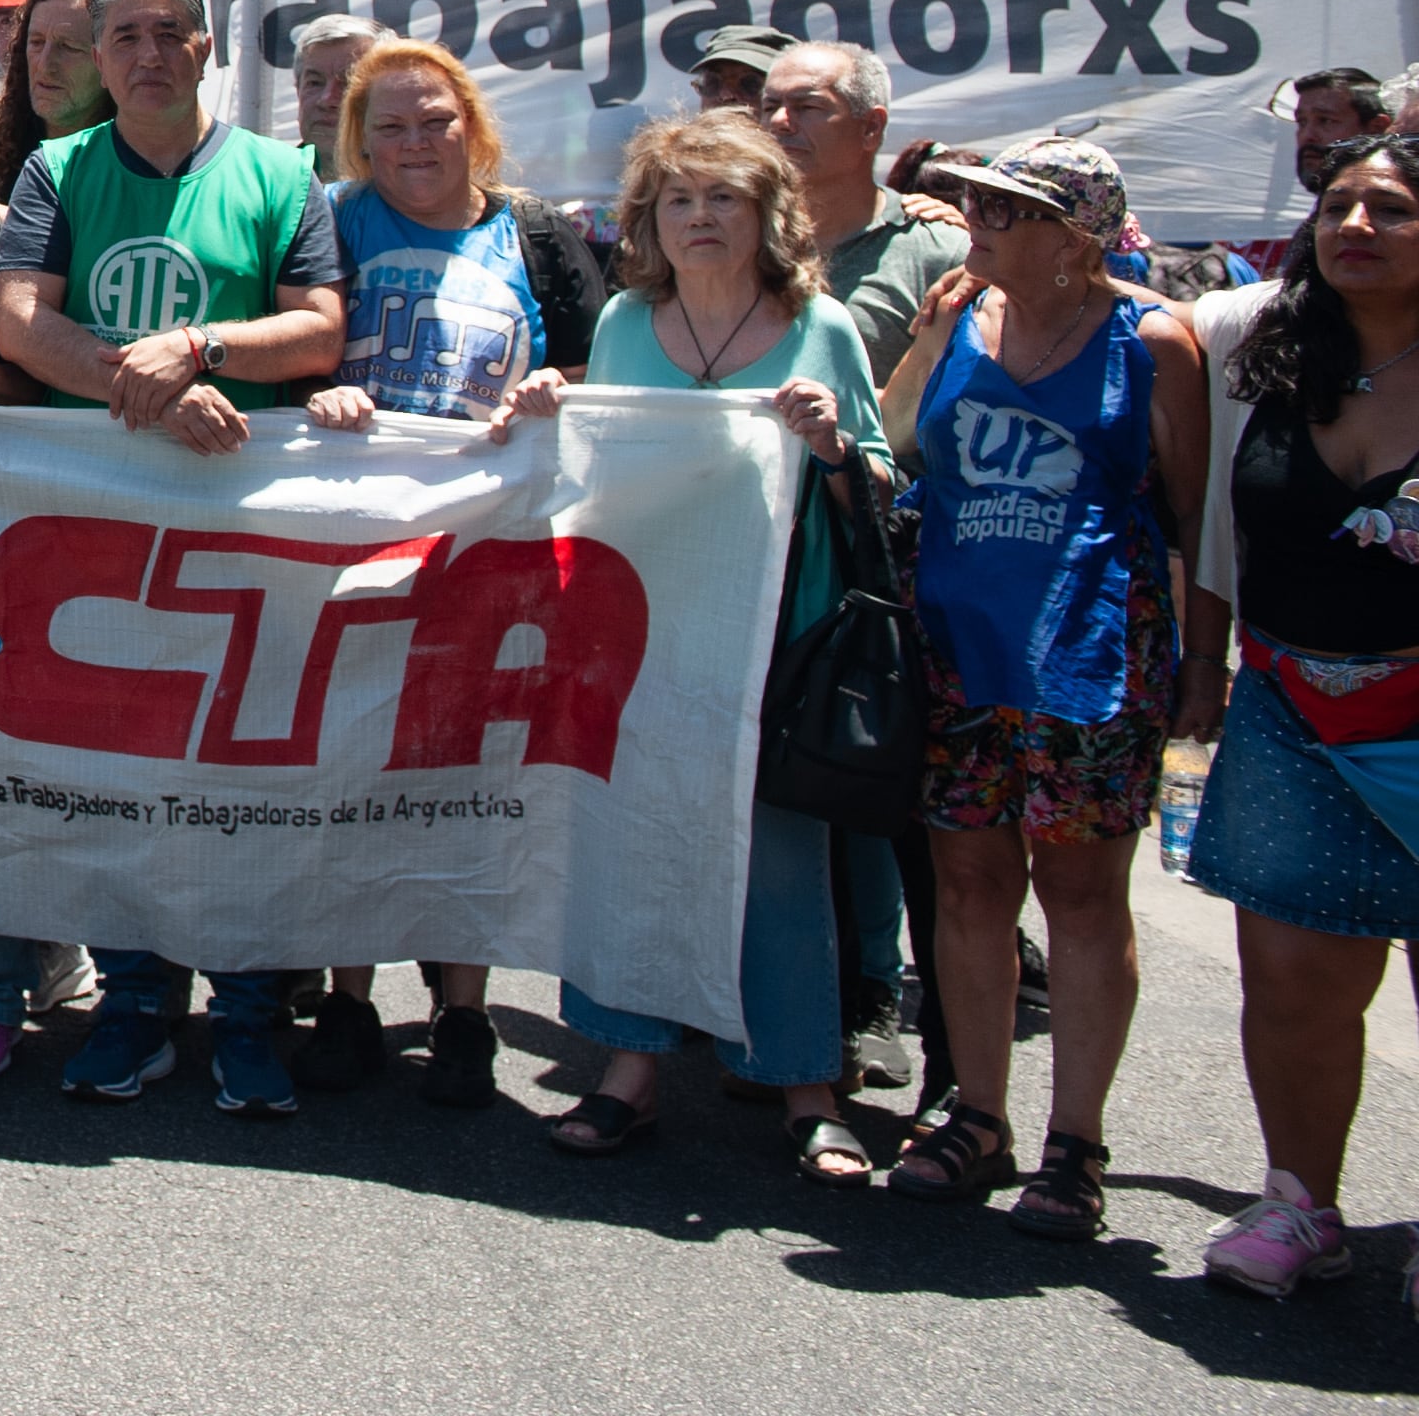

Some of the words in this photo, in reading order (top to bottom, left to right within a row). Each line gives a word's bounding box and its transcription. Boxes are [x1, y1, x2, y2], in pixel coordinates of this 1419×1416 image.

[98, 246, 196, 334] ATE
[390, 367, 416, 383] de
[969, 412, 1068, 480] UP
[955, 517, 1063, 546] popular
[957, 490, 1068, 526] unidad
[7, 775, 139, 823] Trabajadores
[161, 795, 322, 836] Trabajadoras
[329, 800, 358, 824] de
[365, 797, 385, 823] la
[393, 790, 525, 828] Argentina
